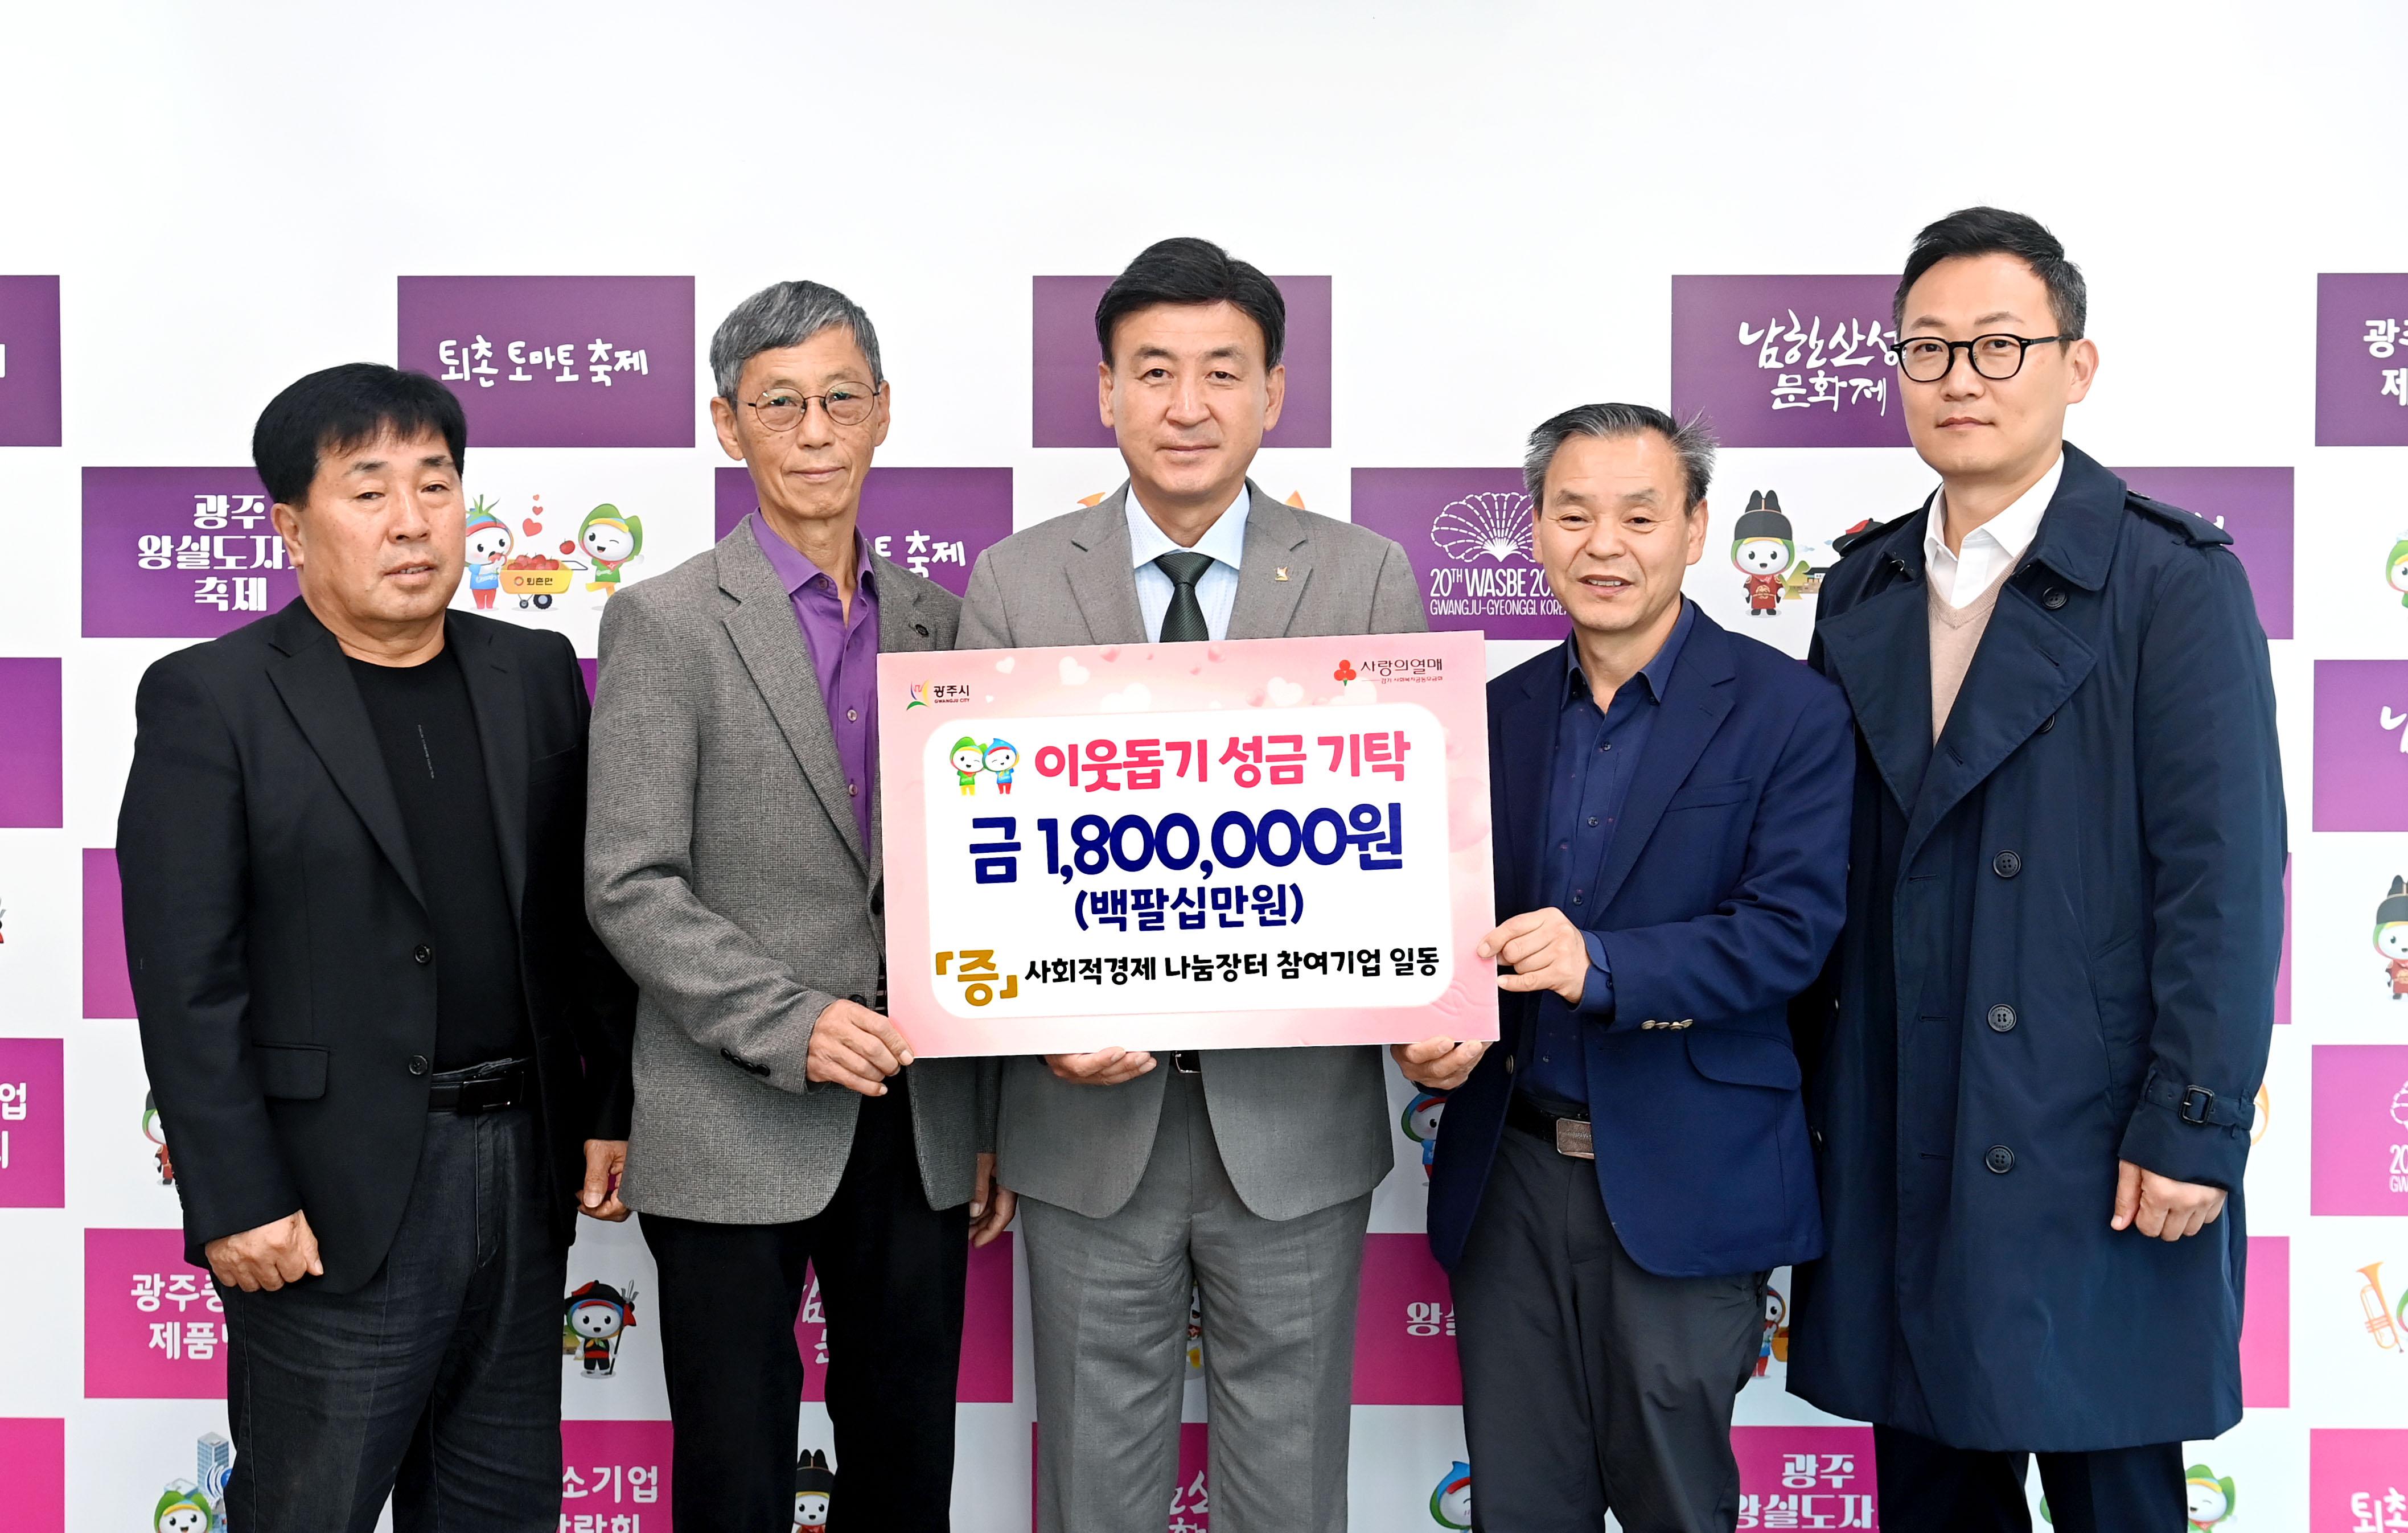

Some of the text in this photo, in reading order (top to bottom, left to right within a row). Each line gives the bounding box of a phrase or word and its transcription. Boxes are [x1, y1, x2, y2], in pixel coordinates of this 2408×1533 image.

[1739, 309, 1897, 368] 남한산성
[439, 334, 648, 388] 퇴촌 토마토 축제
[1770, 370, 1887, 417] 문화제
[194, 495, 266, 529] 광주
[138, 535, 295, 570] 왕실도자
[905, 530, 966, 578] 축제
[194, 577, 267, 611] 축제
[1430, 568, 1554, 597] 20TH WASBE 20
[1540, 599, 1567, 615] KORE
[1361, 658, 1443, 677] 사랑의열매
[934, 685, 969, 698] 광주시
[1034, 730, 1411, 792] 이웃돕기 성금 기탁
[969, 802, 1403, 885] 금 1,800,000원
[1075, 882, 1304, 932] (백팔십만원)
[1024, 956, 1156, 985] 사회적경제
[1165, 953, 1268, 983] 나눔장터
[1276, 949, 1380, 980] 참여기업
[1390, 947, 1439, 976] 일동
[1782, 1454, 1855, 1489] 광주
[1736, 1493, 1879, 1529] 왕실도자
